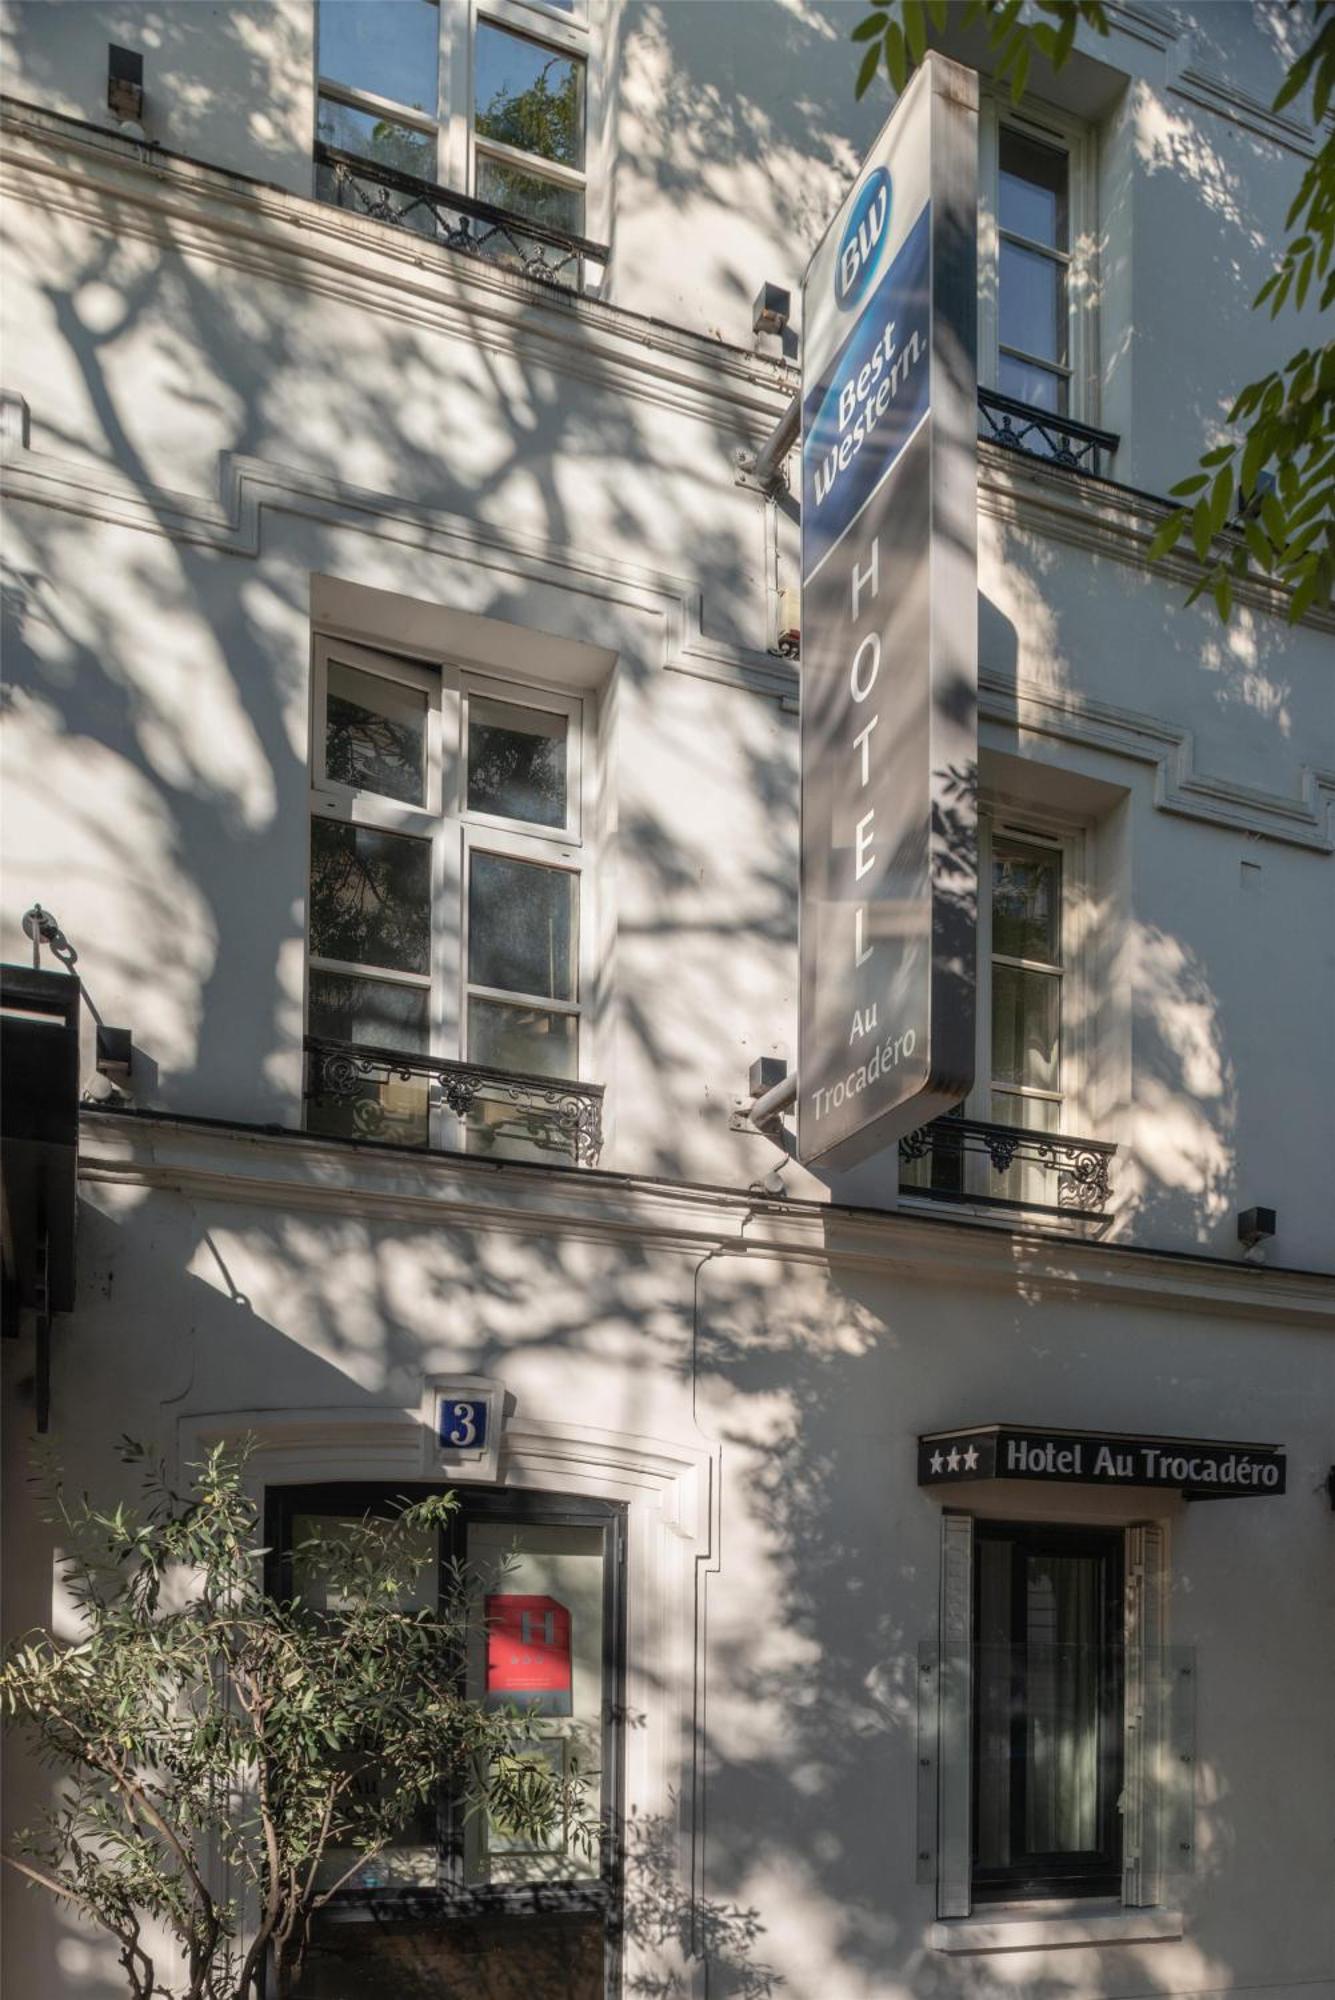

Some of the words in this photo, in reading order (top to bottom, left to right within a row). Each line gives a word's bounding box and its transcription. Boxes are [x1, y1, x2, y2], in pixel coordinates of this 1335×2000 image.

[842, 185, 886, 298] BW
[838, 321, 896, 433] Best
[850, 535, 881, 969] HOTEL
[848, 1002, 878, 1046] Au
[812, 1028, 916, 1121] Trocadéro
[450, 1402, 475, 1447] 3
[1007, 1440, 1081, 1475] Hotel
[1094, 1446, 1133, 1477] Au
[1141, 1448, 1279, 1486] Trocadéro
[521, 1611, 554, 1645] H
